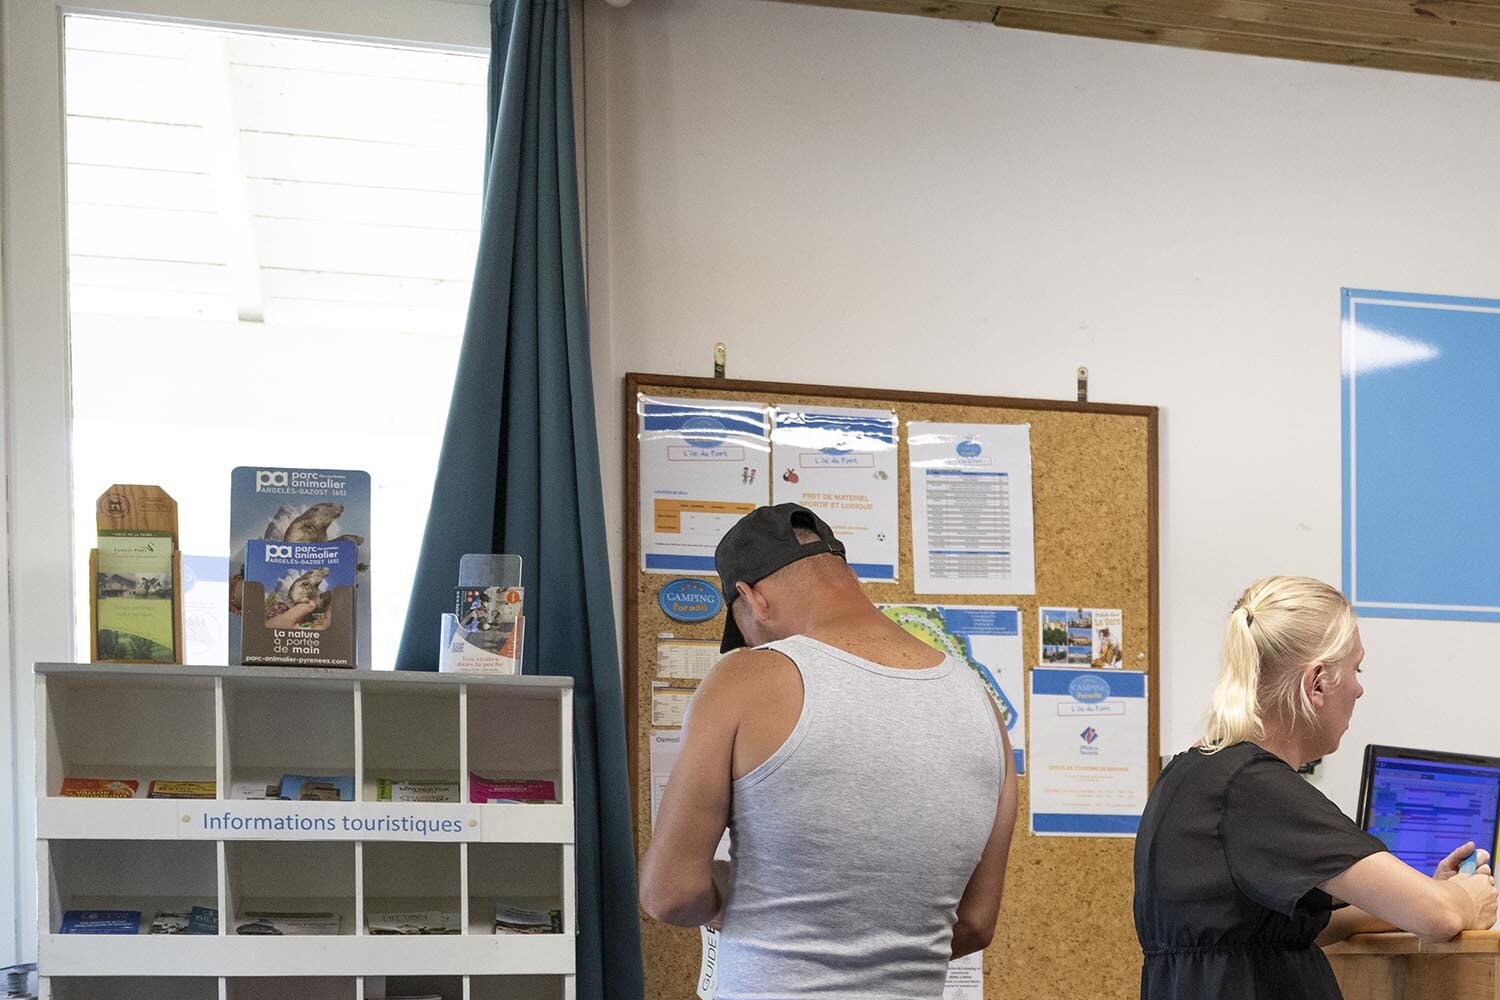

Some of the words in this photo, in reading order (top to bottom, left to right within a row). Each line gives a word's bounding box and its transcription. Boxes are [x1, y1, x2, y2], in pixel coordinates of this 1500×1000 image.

[292, 472, 318, 481] parc
[291, 479, 346, 489] animalier
[295, 546, 317, 554] parc
[294, 551, 339, 559] animalier
[666, 592, 716, 604] CAMPING
[274, 629, 285, 637] La
[288, 630, 320, 639] nature
[286, 637, 320, 646] portée
[274, 645, 288, 653] de
[292, 645, 320, 654] main
[203, 812, 336, 832] Informations
[342, 815, 462, 836] touristiques
[702, 936, 717, 992] GUIDE
